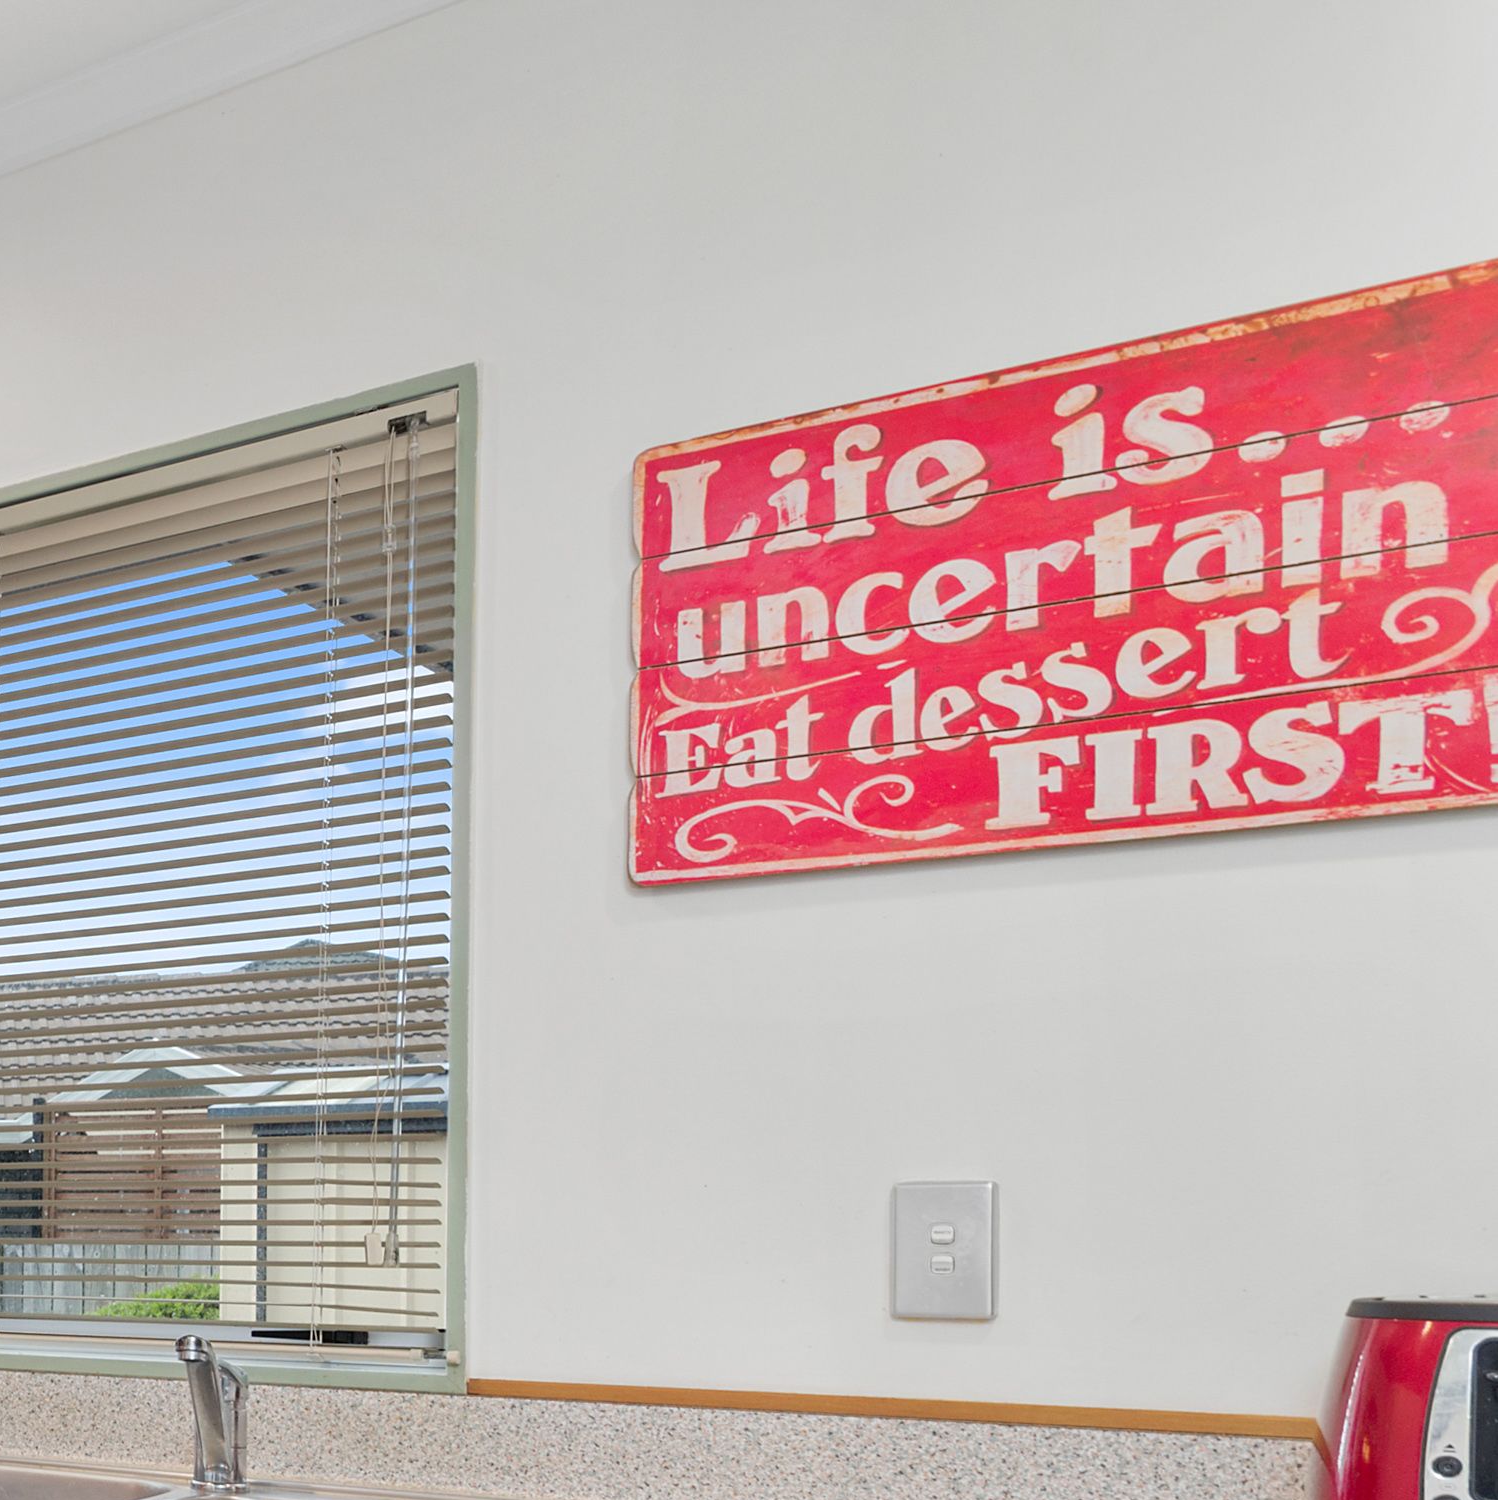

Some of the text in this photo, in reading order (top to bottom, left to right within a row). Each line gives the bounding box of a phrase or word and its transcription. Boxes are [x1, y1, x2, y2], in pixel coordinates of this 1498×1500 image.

[657, 424, 989, 573] Life
[676, 470, 1448, 679] uncertain
[655, 589, 1353, 799] Eat dessert
